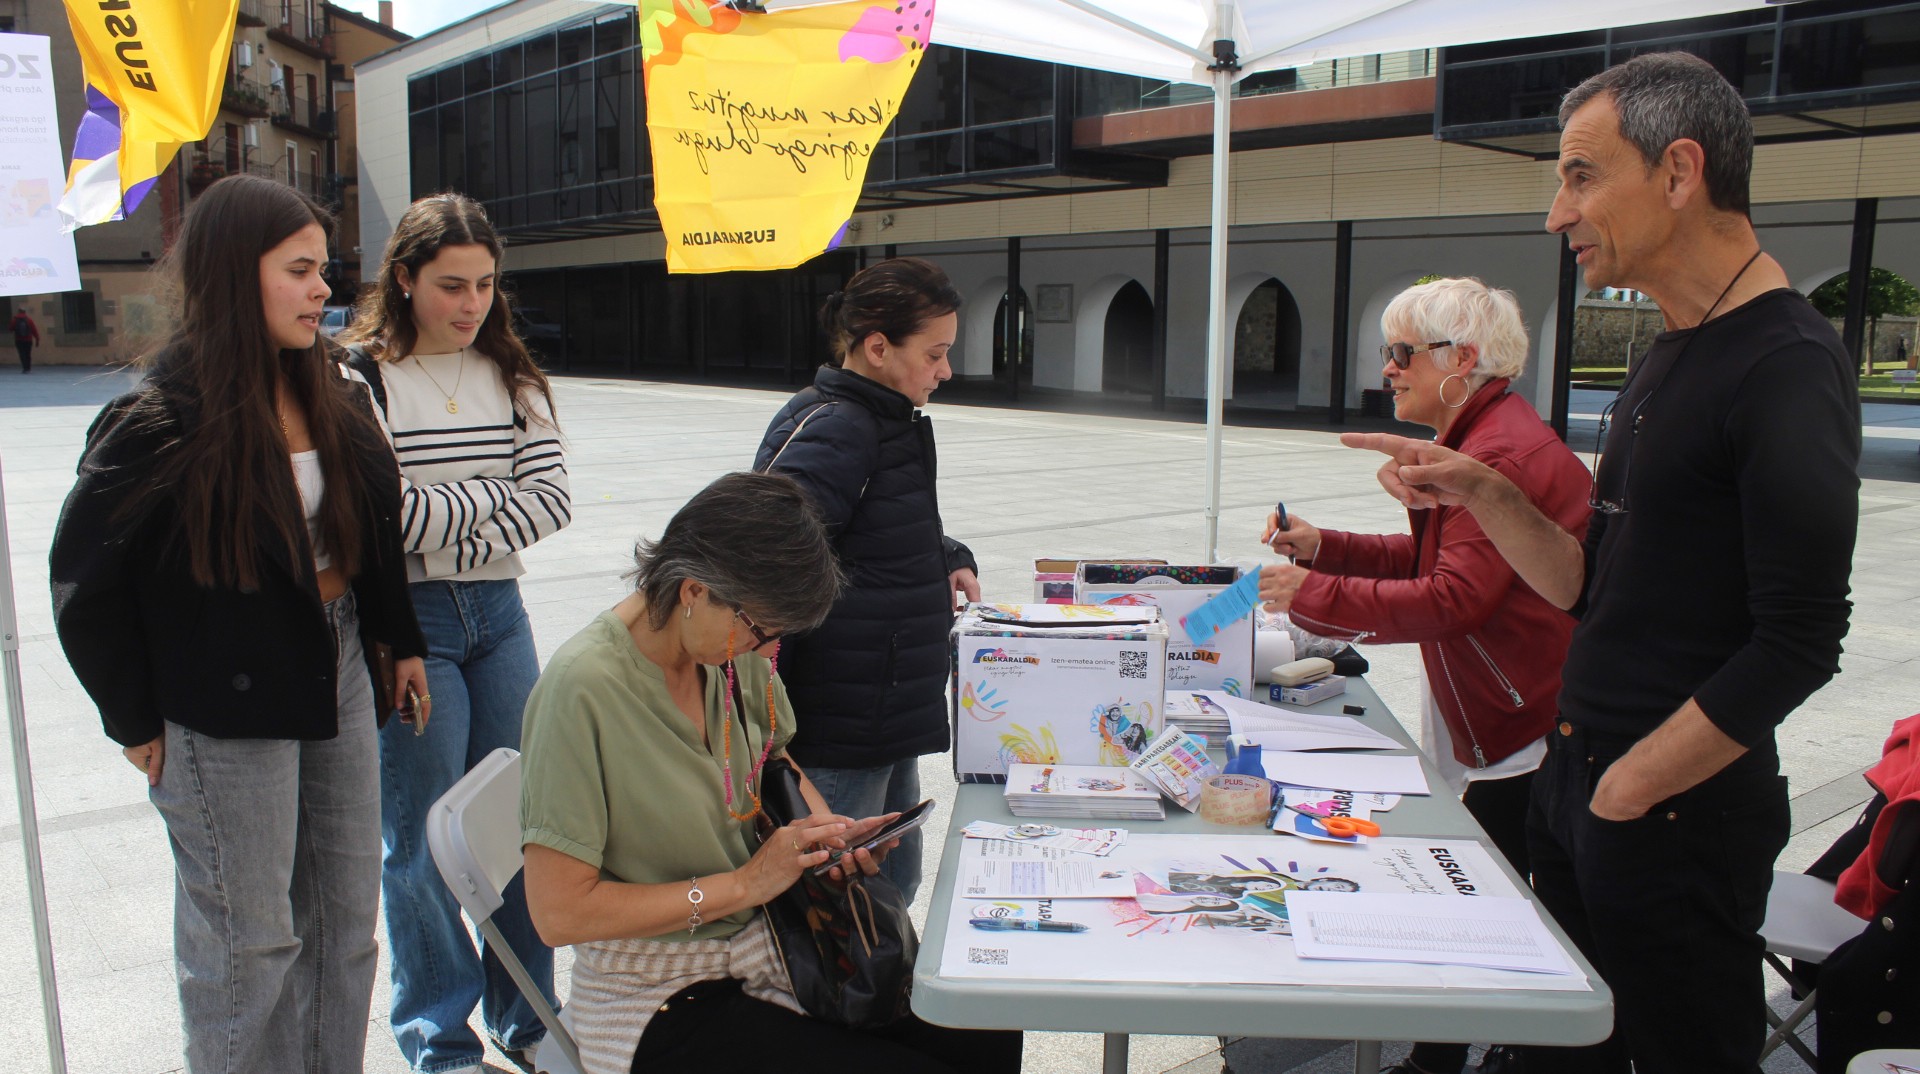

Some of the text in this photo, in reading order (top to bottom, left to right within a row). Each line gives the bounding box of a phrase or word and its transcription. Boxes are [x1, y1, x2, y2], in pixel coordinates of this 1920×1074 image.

[983, 656, 1037, 664] EUSKARALDIA
[1168, 651, 1214, 661] RALDIA
[1050, 657, 1094, 665] Izen-ematea
[1038, 899, 1052, 921] TXAP
